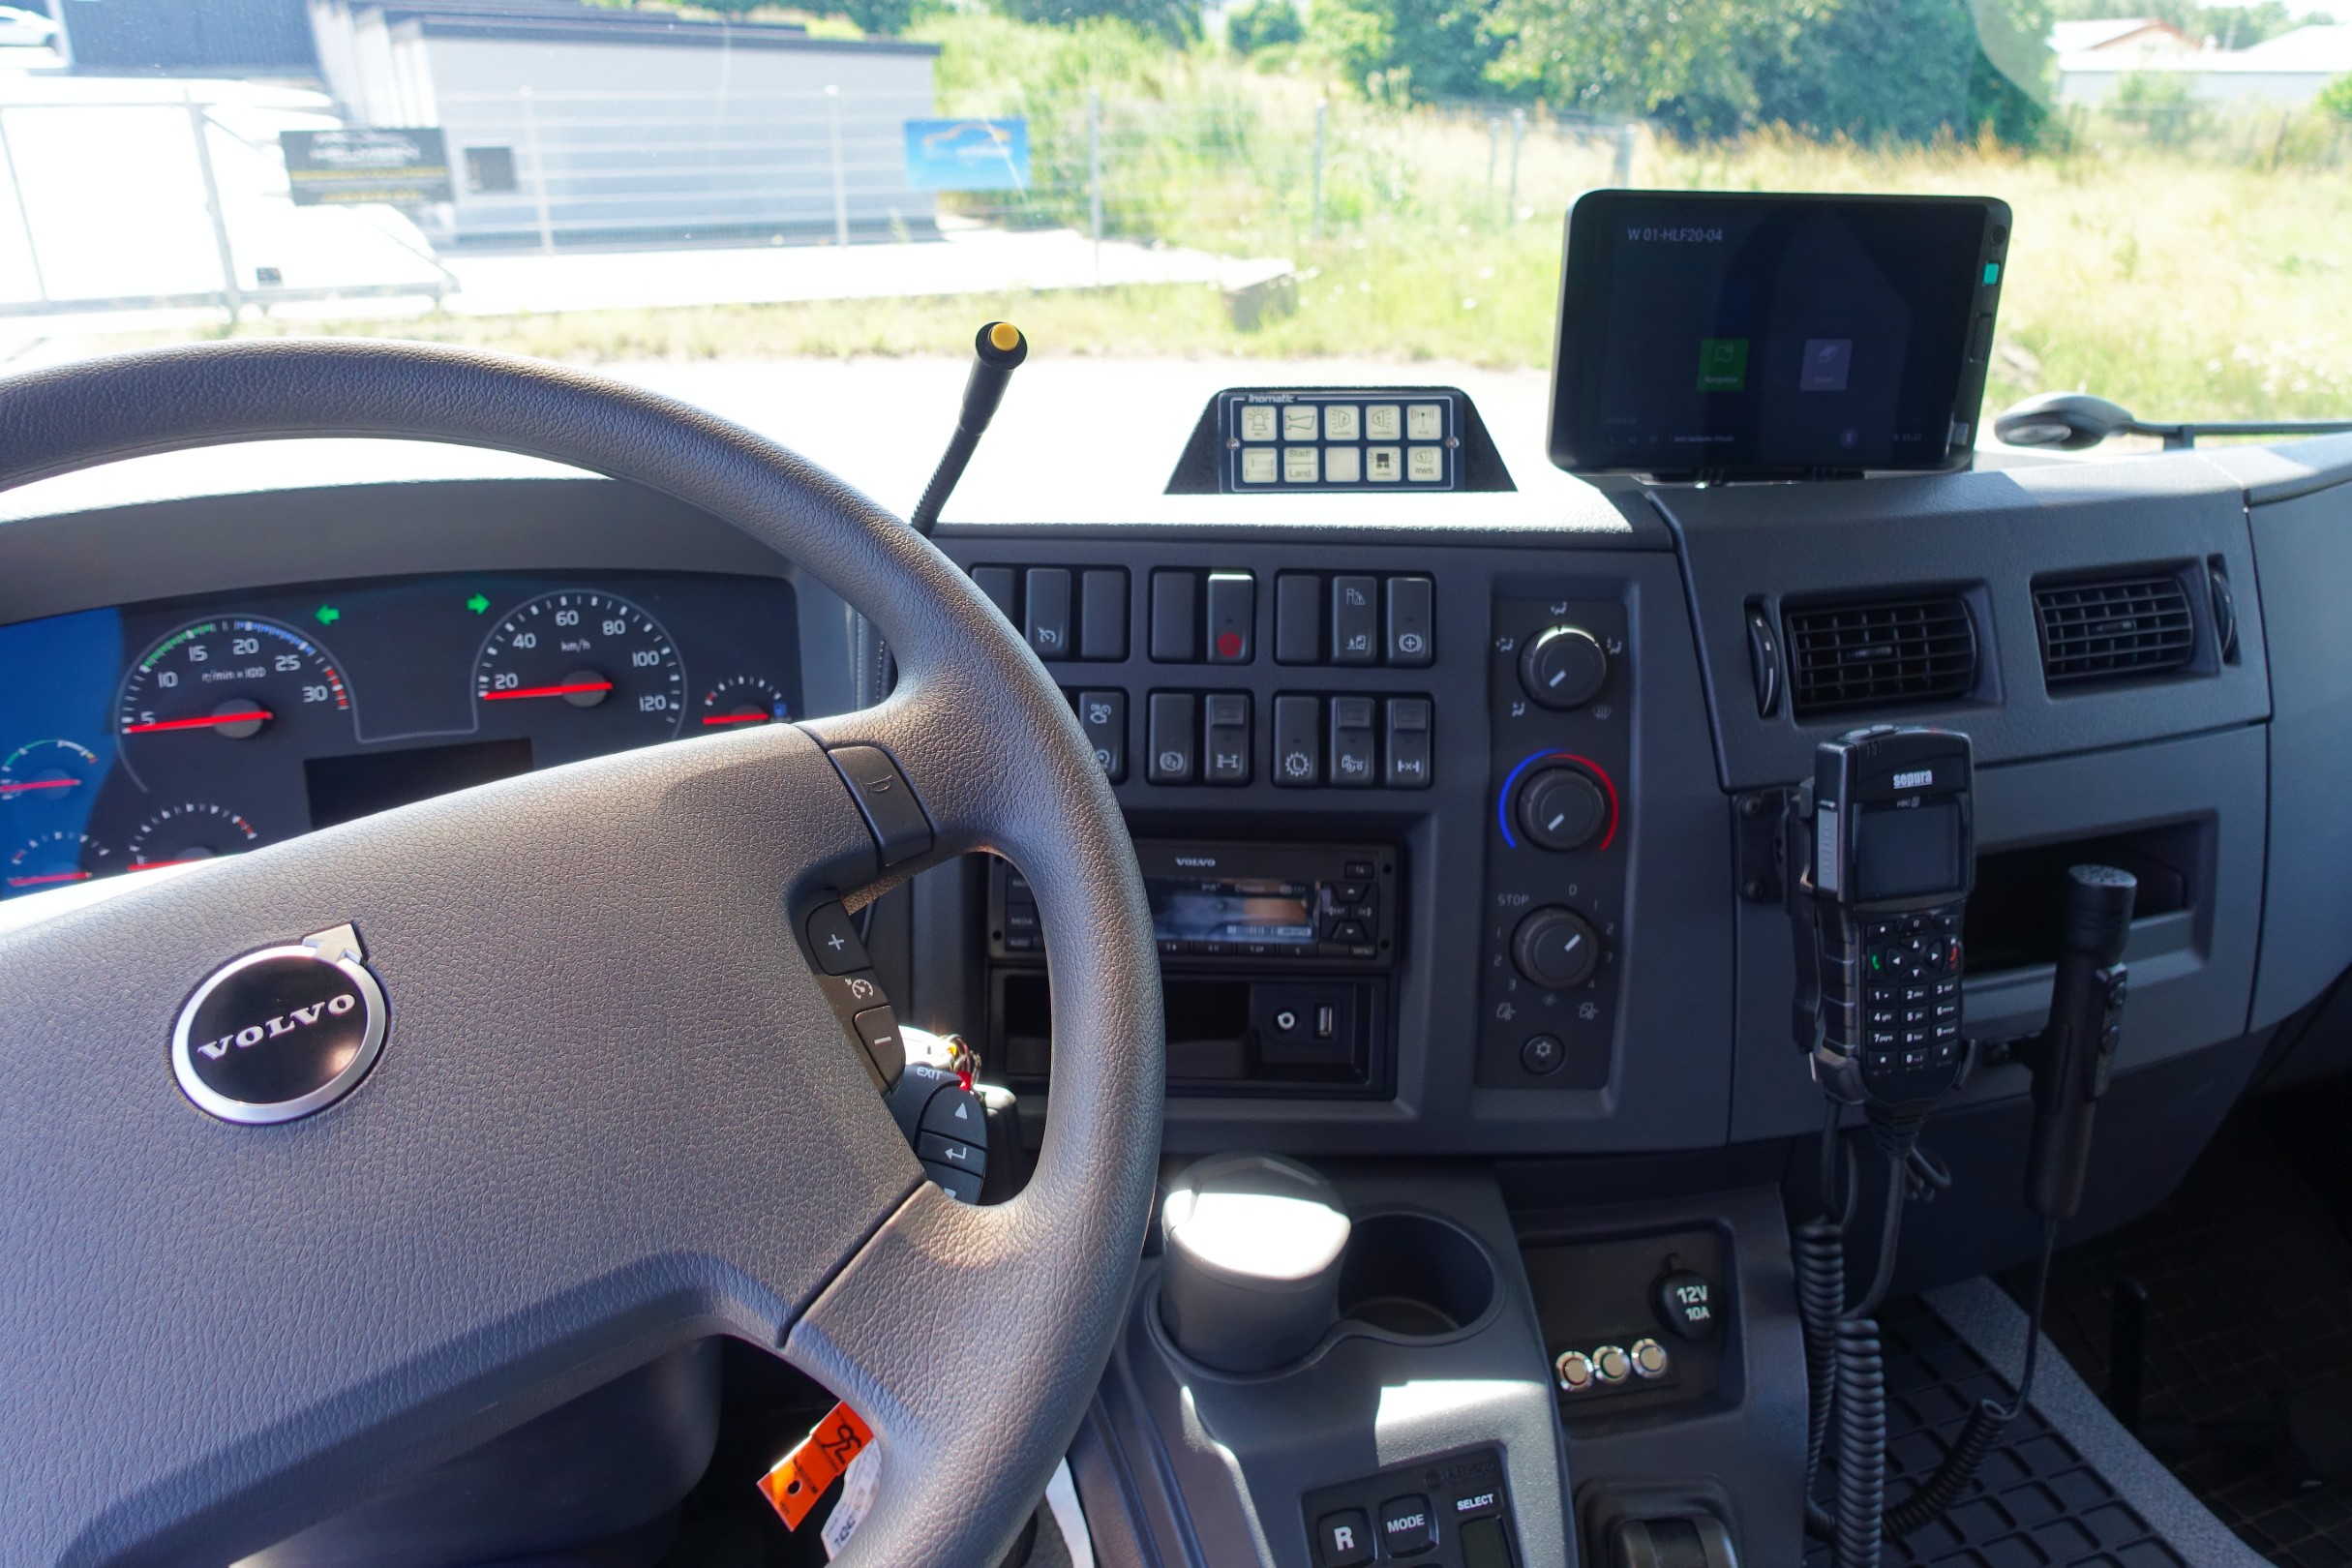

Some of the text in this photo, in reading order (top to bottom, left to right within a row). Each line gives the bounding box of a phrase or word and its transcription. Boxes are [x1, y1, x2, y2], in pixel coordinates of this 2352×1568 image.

[1628, 228, 1641, 241] W
[1289, 468, 1312, 477] Land
[556, 610, 579, 626] 60
[602, 619, 625, 636] 80
[232, 639, 259, 654] 20
[512, 633, 536, 649] 40
[560, 640, 590, 652] km/h
[189, 646, 207, 662] 15
[632, 650, 659, 667] 100
[275, 654, 301, 672] 25
[158, 672, 178, 688] 10
[495, 673, 518, 689] 20
[302, 685, 328, 703] 30
[639, 695, 666, 711] 120
[1893, 769, 1932, 789] sepura
[1175, 858, 1216, 867] VOLVO
[1569, 883, 1578, 896] 0
[1497, 893, 1529, 906] STOP
[1607, 922, 1614, 935] 2
[1493, 954, 1502, 968] 2
[1510, 979, 1517, 991] 3
[197, 993, 356, 1060] VOLVO
[917, 1067, 943, 1080] EXIT
[1676, 1284, 1708, 1305] 12V
[1685, 1306, 1711, 1321] 10A
[1457, 1493, 1493, 1511] SELECT
[1387, 1514, 1425, 1533] MODE
[1334, 1526, 1355, 1552] R
